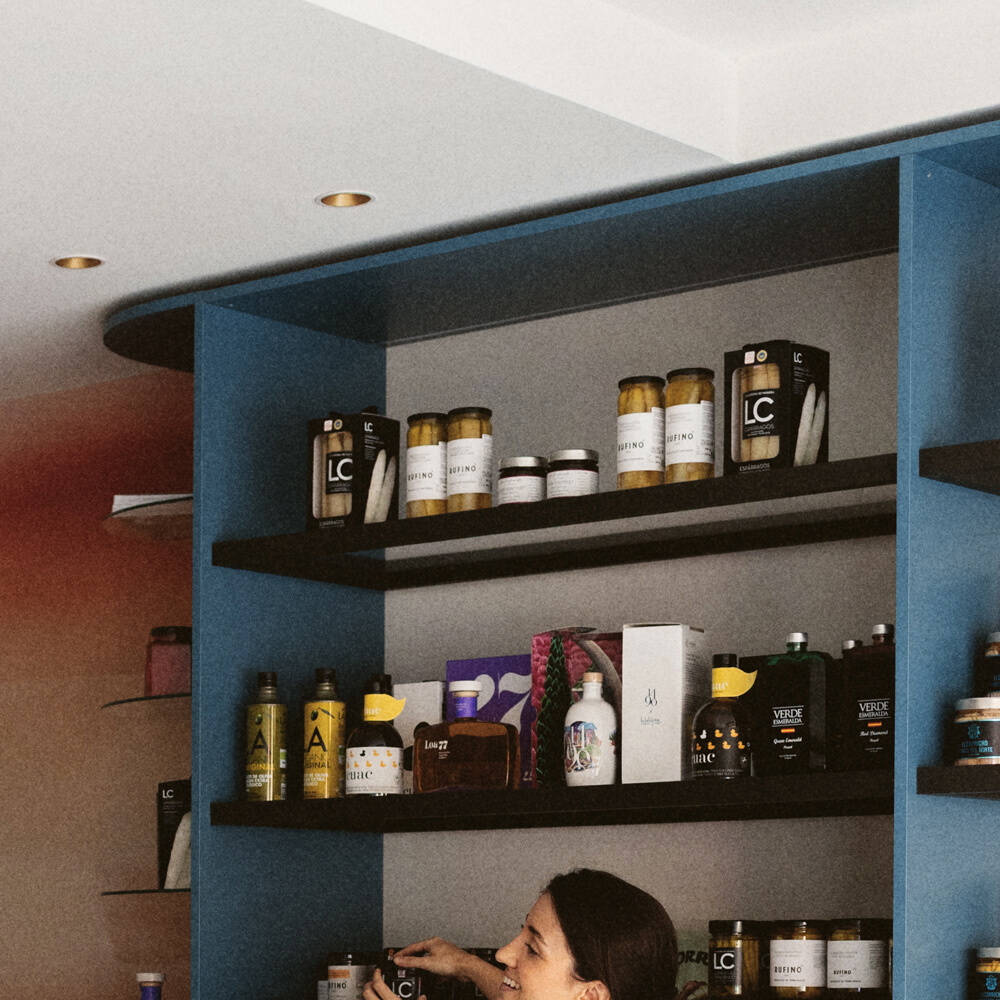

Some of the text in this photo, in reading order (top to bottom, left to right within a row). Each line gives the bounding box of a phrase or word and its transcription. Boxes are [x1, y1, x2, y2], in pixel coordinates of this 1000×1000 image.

[793, 351, 803, 364] LC
[744, 396, 775, 425] LC
[364, 421, 373, 433] LC
[328, 458, 353, 482] LC
[858, 701, 889, 712] VERDE
[773, 708, 803, 719] VERDE
[162, 789, 174, 799] LC
[713, 952, 735, 970] LC
[774, 966, 802, 974] RUFINO
